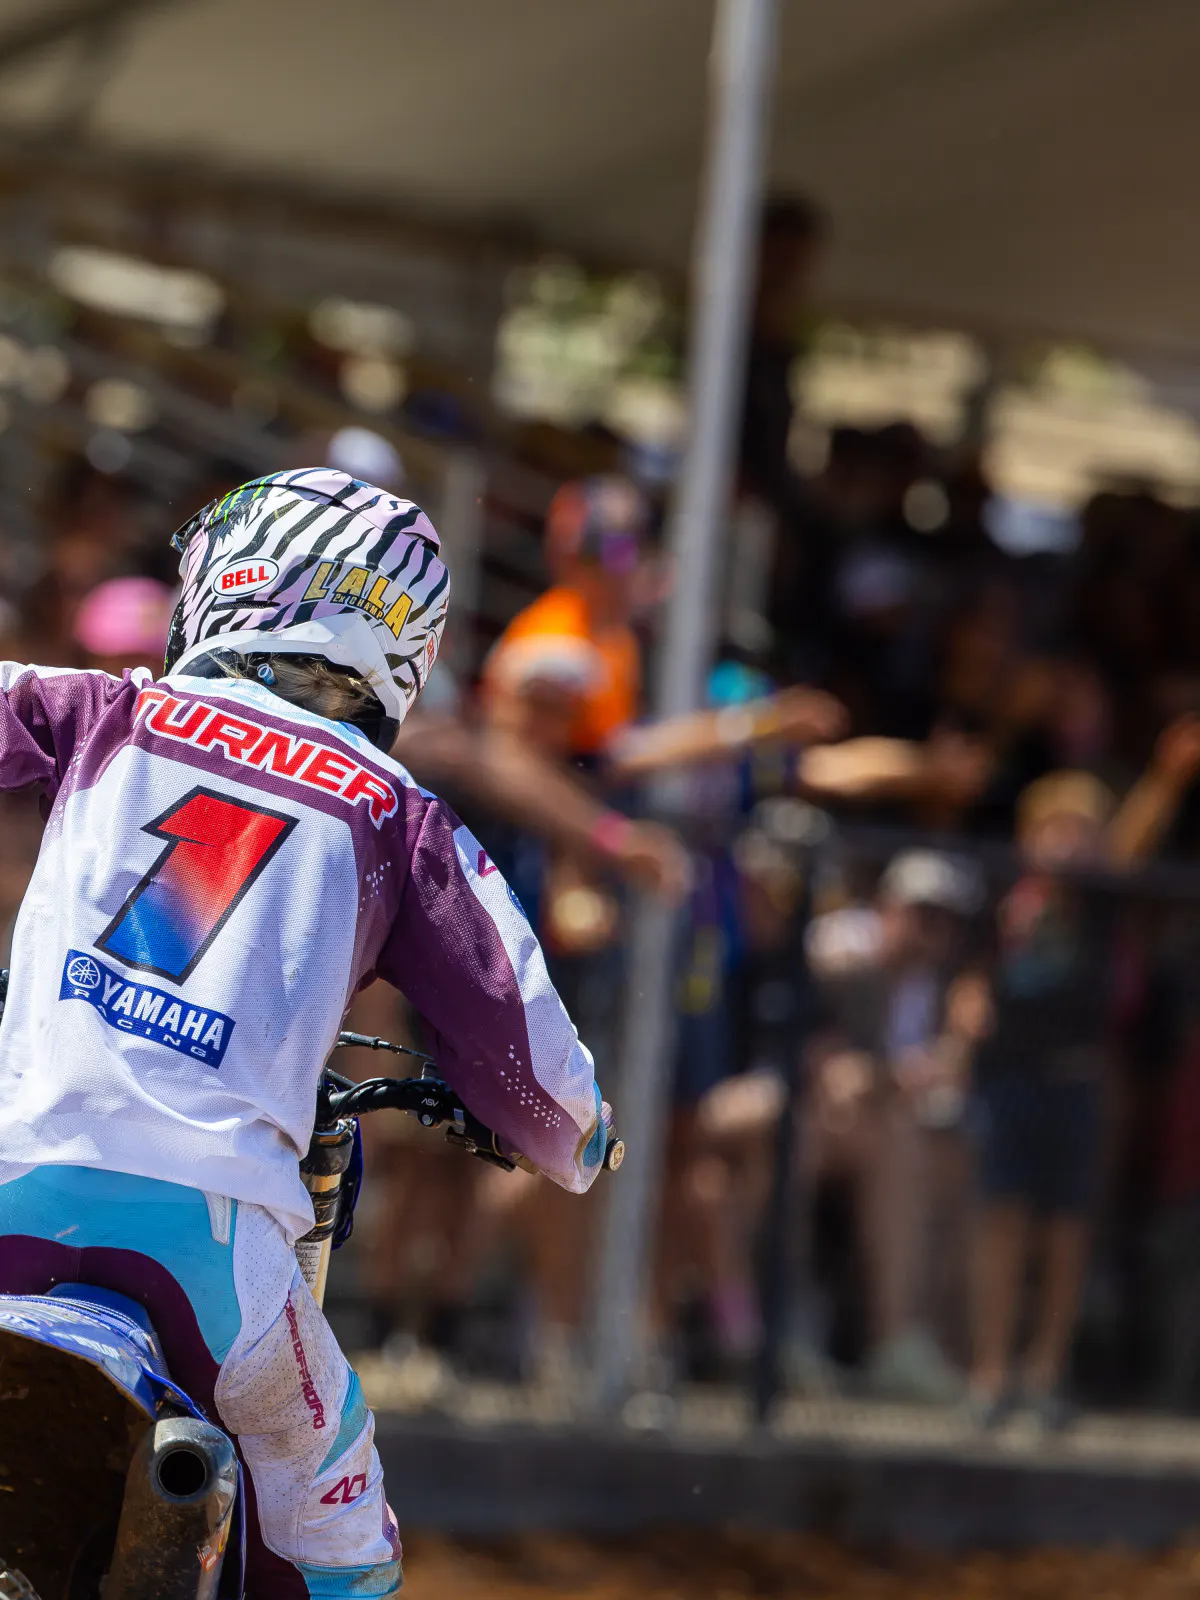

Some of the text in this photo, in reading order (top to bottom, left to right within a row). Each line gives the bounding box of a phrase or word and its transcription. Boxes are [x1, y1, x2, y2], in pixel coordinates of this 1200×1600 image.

[221, 565, 270, 590] BELL
[302, 561, 413, 641] LALA
[348, 596, 385, 620] CHAMP
[134, 688, 398, 829] TURNER
[93, 785, 300, 986] 1
[73, 987, 208, 1057] RACING
[101, 974, 225, 1050] YAMAHA
[421, 1097, 439, 1107] ASV
